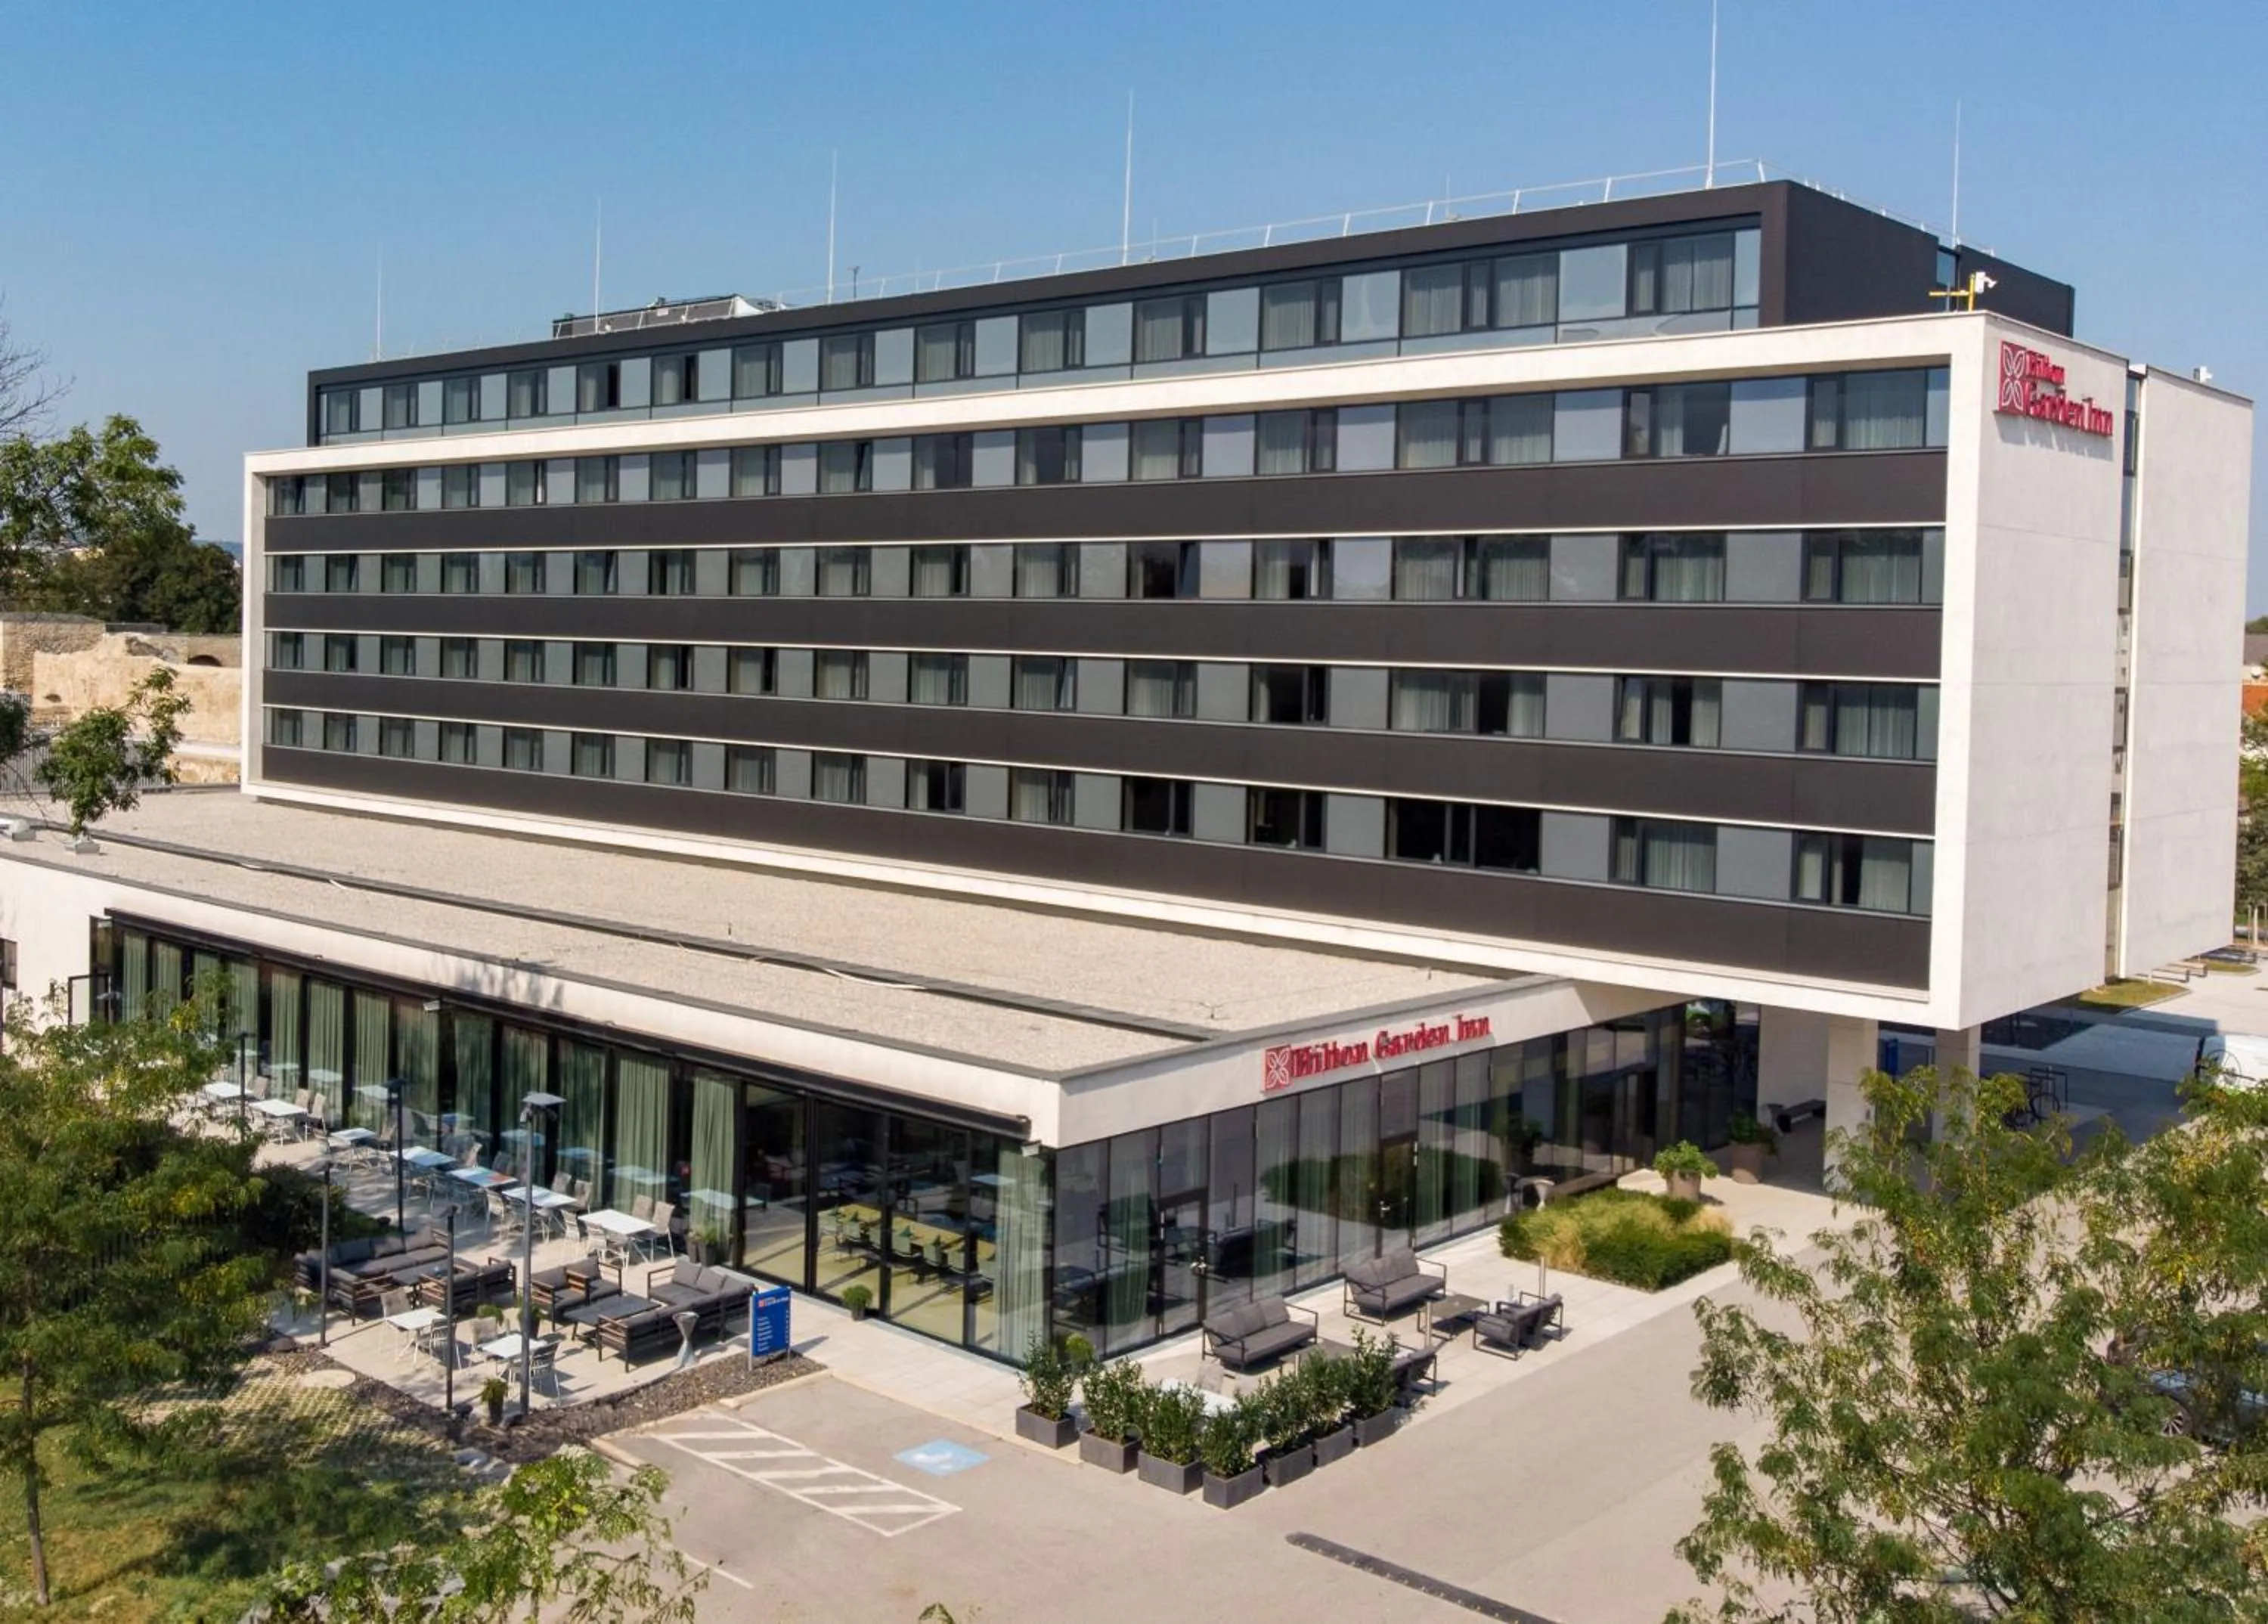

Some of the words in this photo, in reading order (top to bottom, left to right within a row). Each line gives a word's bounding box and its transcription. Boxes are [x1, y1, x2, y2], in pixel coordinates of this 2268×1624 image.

[2024, 380, 2084, 428] Garden
[2083, 397, 2113, 436] Inn
[1290, 1040, 1369, 1077] Hilton
[1375, 1022, 1449, 1058] Garden
[1454, 1014, 1489, 1041] Inn
